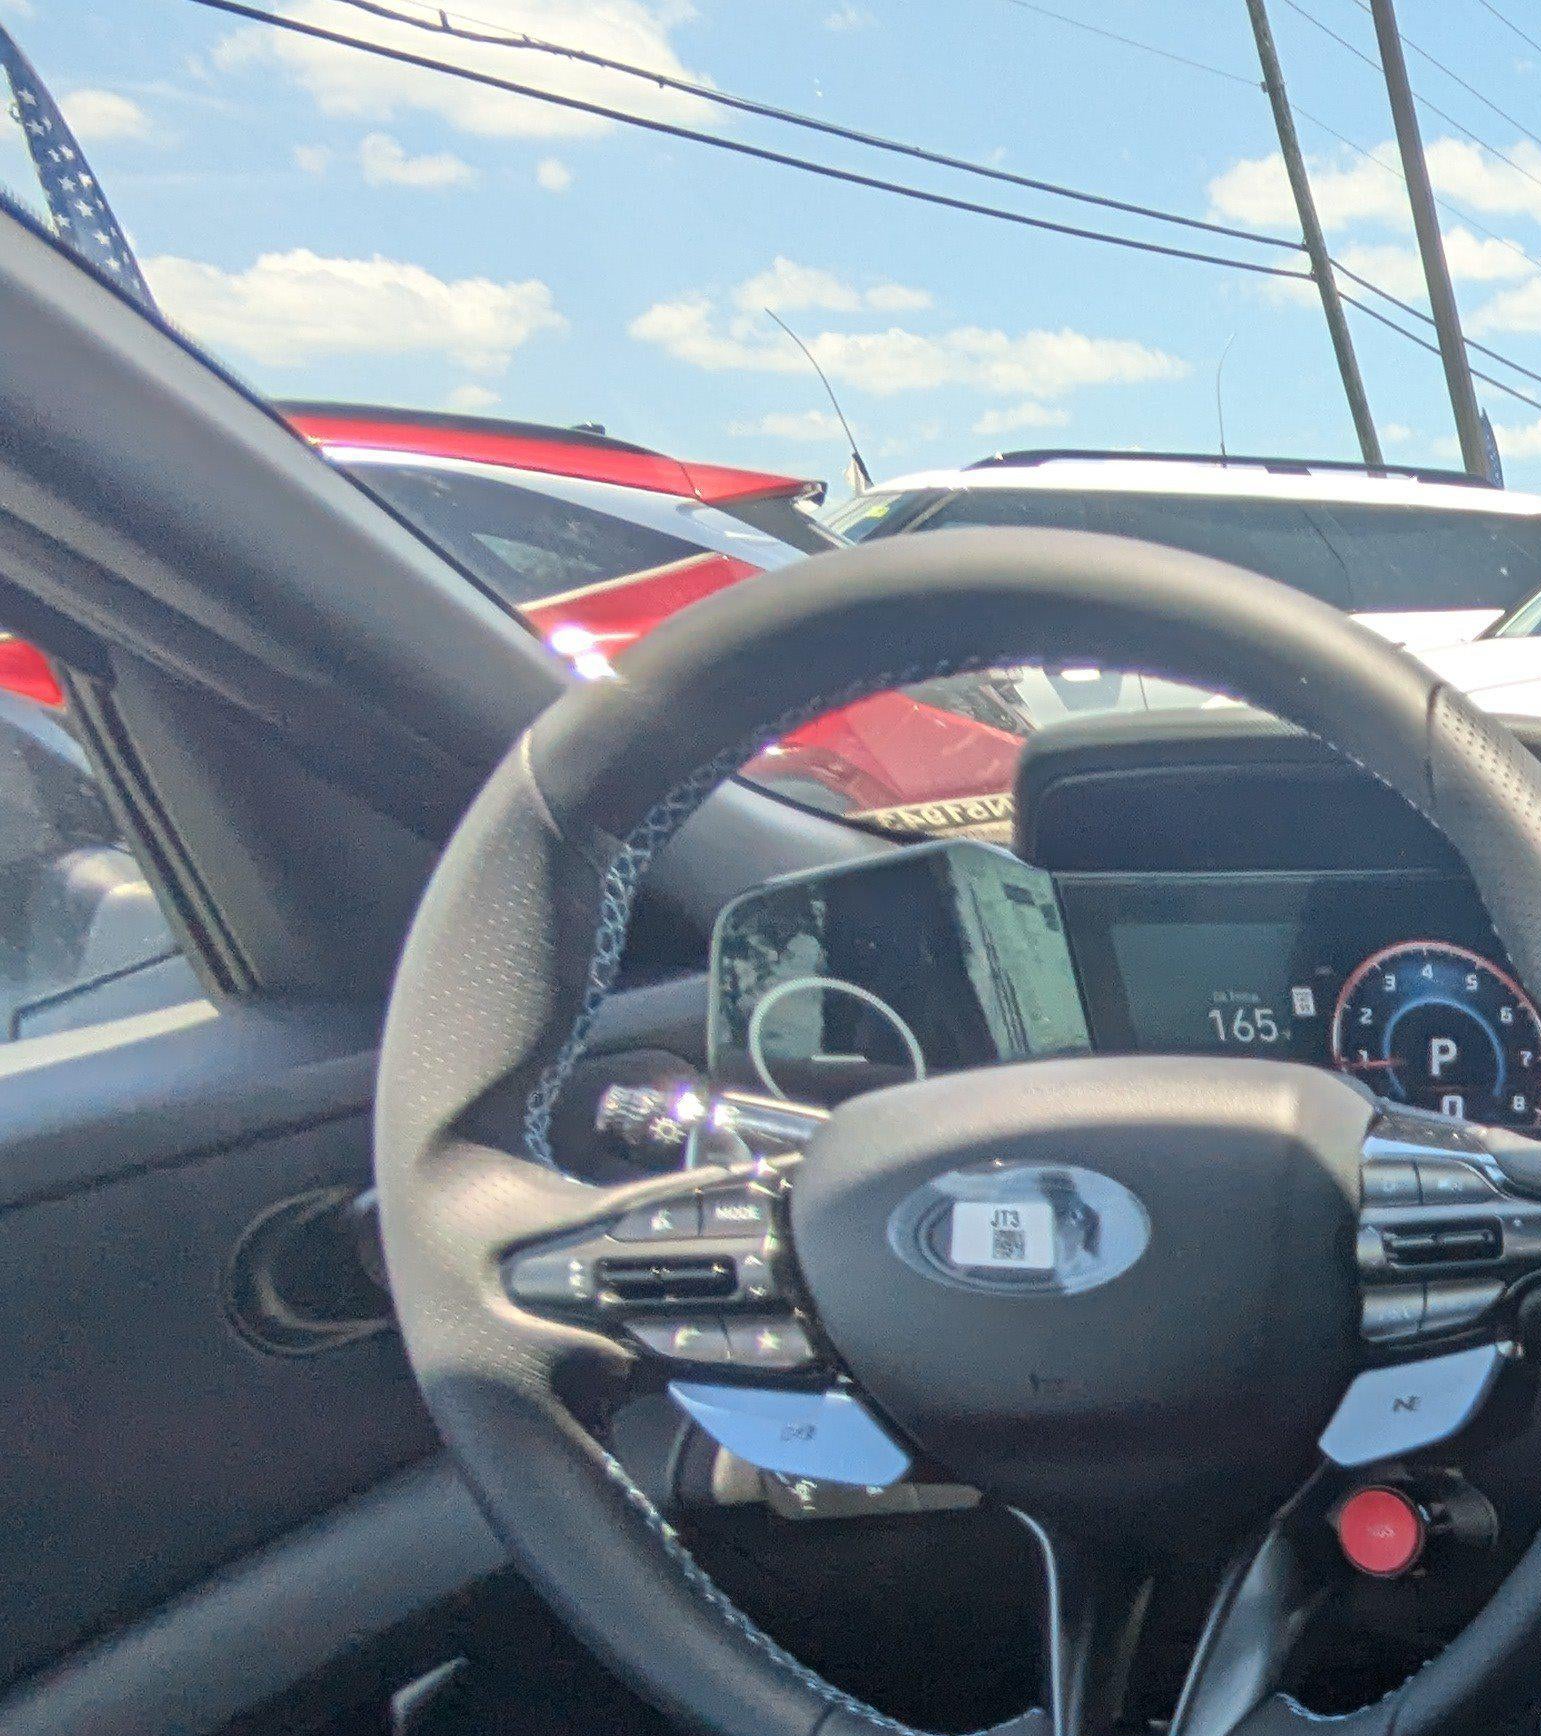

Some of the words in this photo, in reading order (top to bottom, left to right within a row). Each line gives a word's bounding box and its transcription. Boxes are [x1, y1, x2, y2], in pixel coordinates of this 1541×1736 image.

[1421, 963, 1433, 979] 4
[1384, 974, 1396, 992] 3
[1465, 974, 1478, 991] 5
[1359, 1008, 1372, 1025] 2
[1500, 1006, 1513, 1024] 6
[1208, 1007, 1279, 1043] 165
[1430, 1037, 1459, 1078] P
[1519, 1050, 1532, 1067] 7
[1513, 1095, 1526, 1112] 8
[990, 1209, 1020, 1229] JT3
